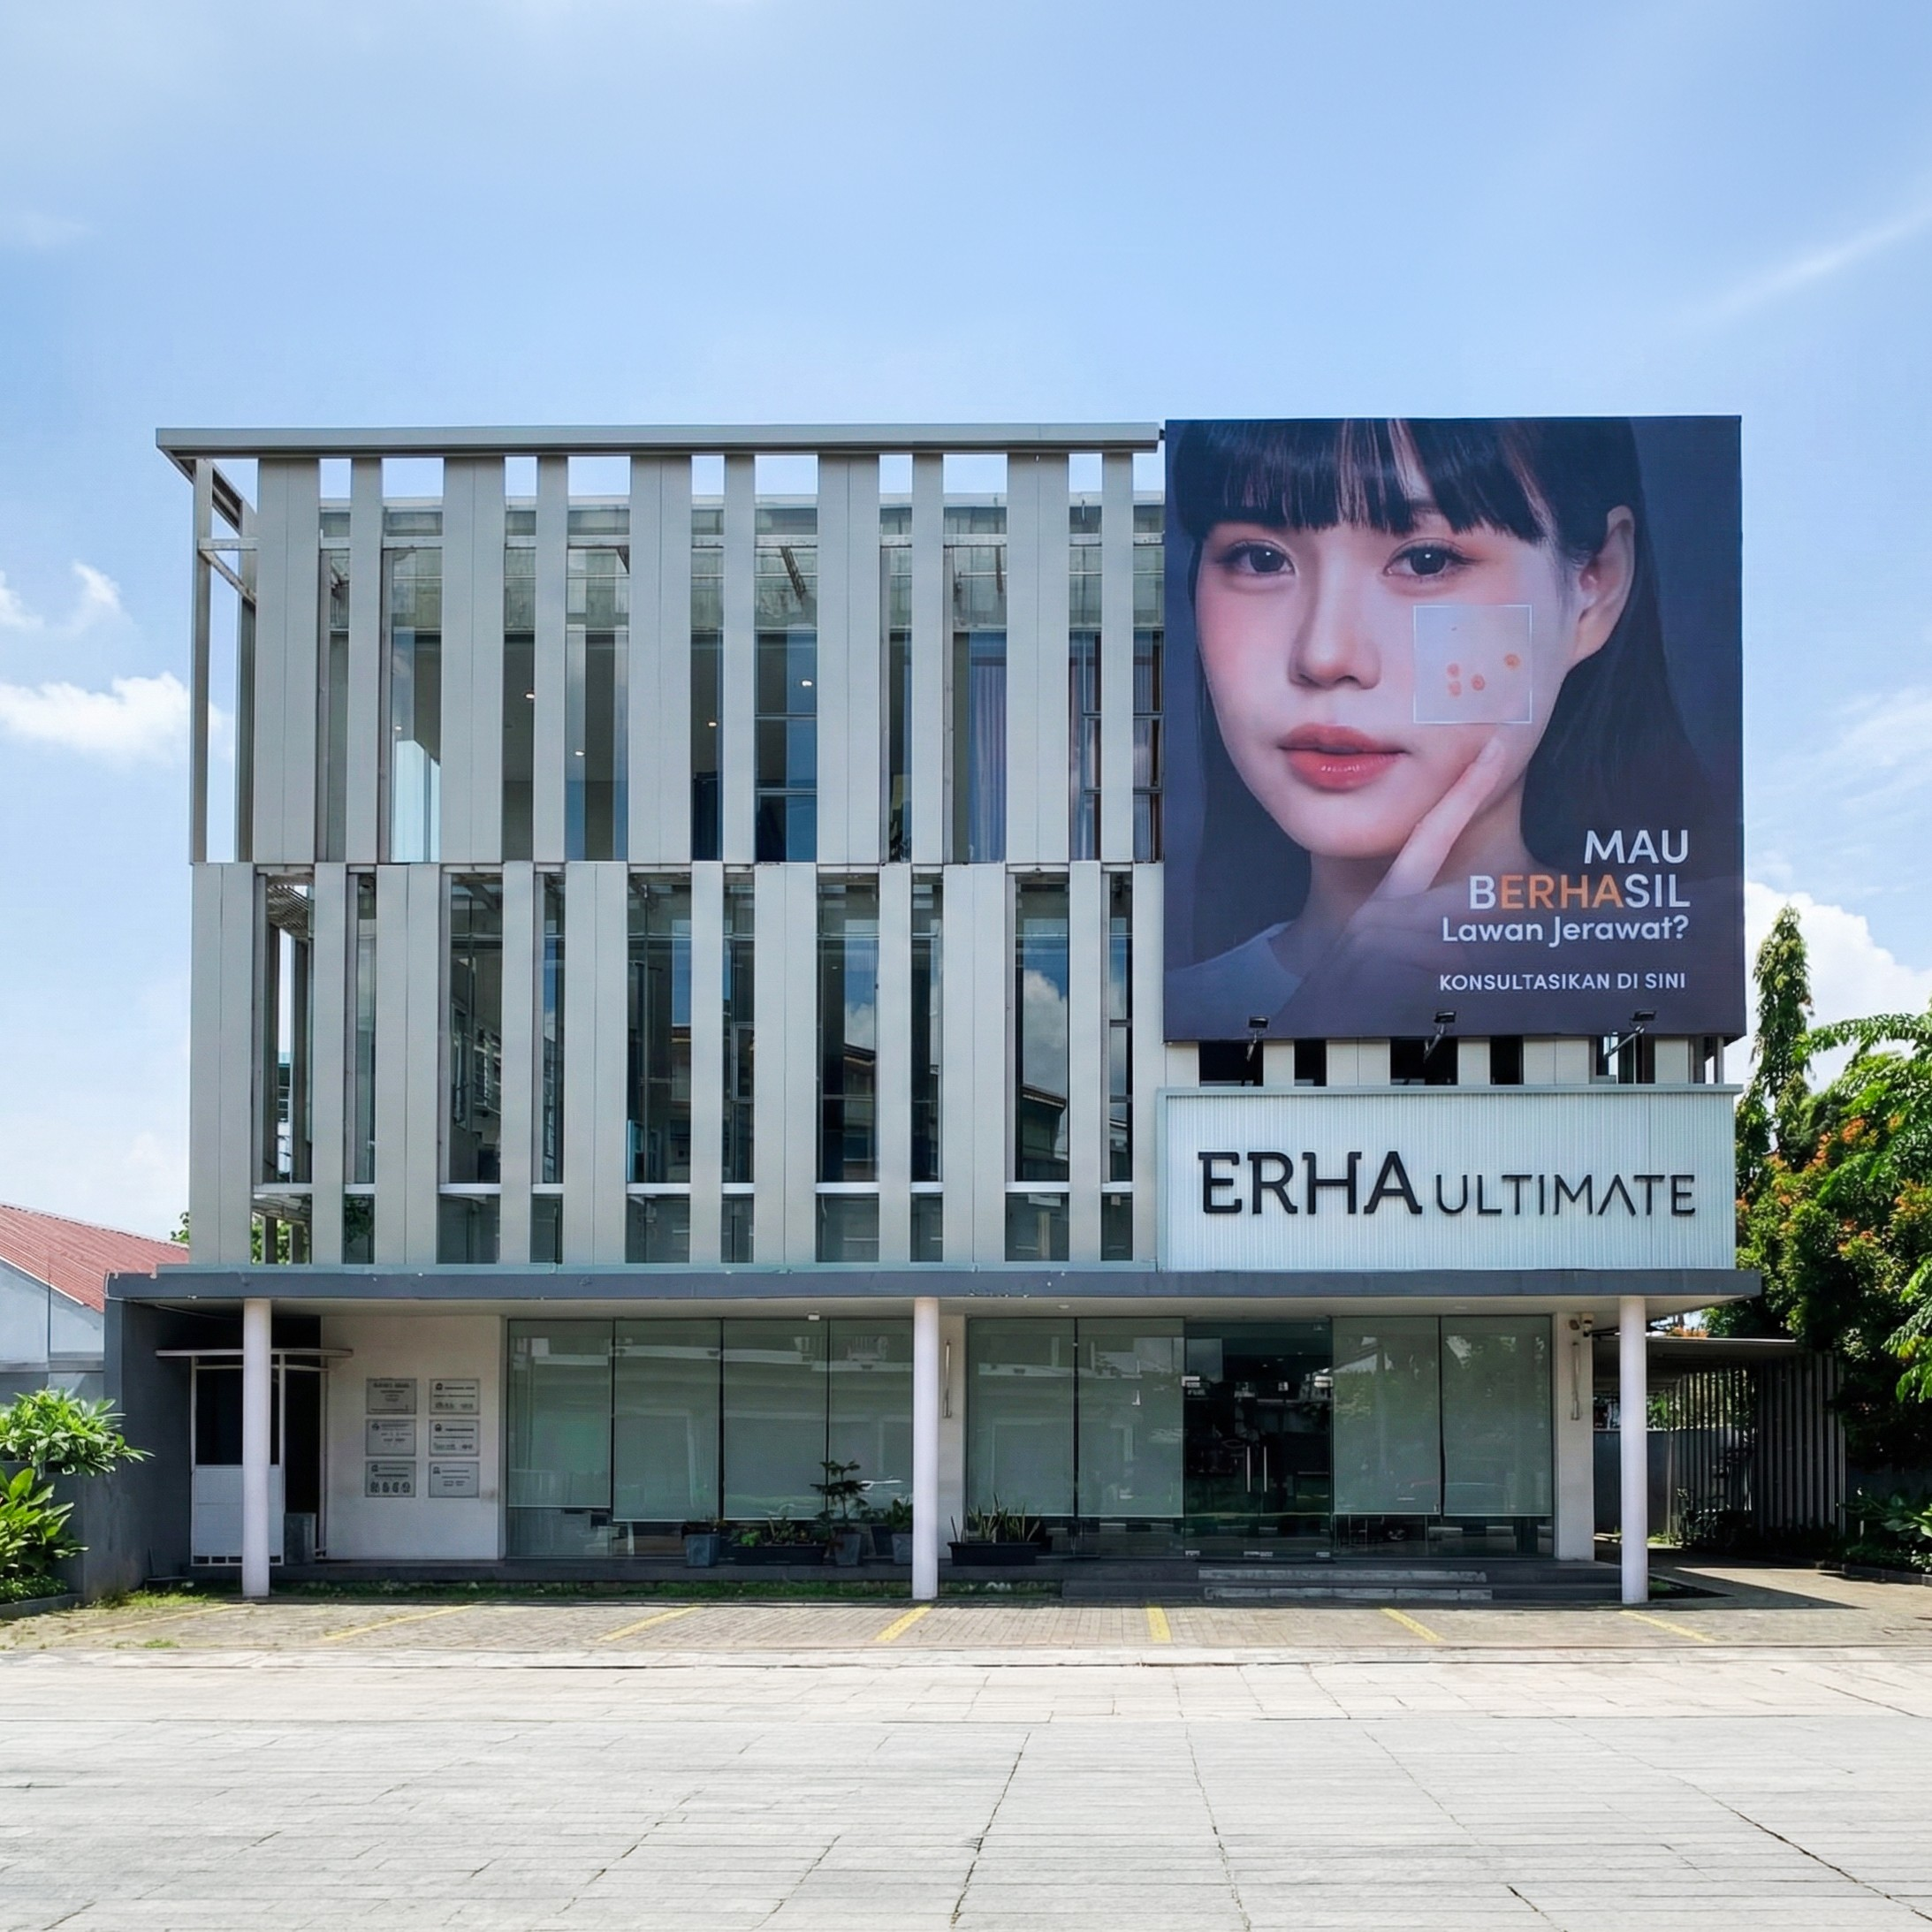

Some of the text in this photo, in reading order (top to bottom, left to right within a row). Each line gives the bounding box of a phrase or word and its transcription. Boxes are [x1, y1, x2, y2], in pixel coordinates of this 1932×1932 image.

[1584, 830, 1688, 864] MAU
[1469, 873, 1691, 909] BERHASIL
[1442, 915, 1689, 947] Lawan Jerawat?
[1439, 973, 1685, 991] KONSULTASIKAN DI SINI
[1198, 1151, 1696, 1218] ERHA ULTIMATE
